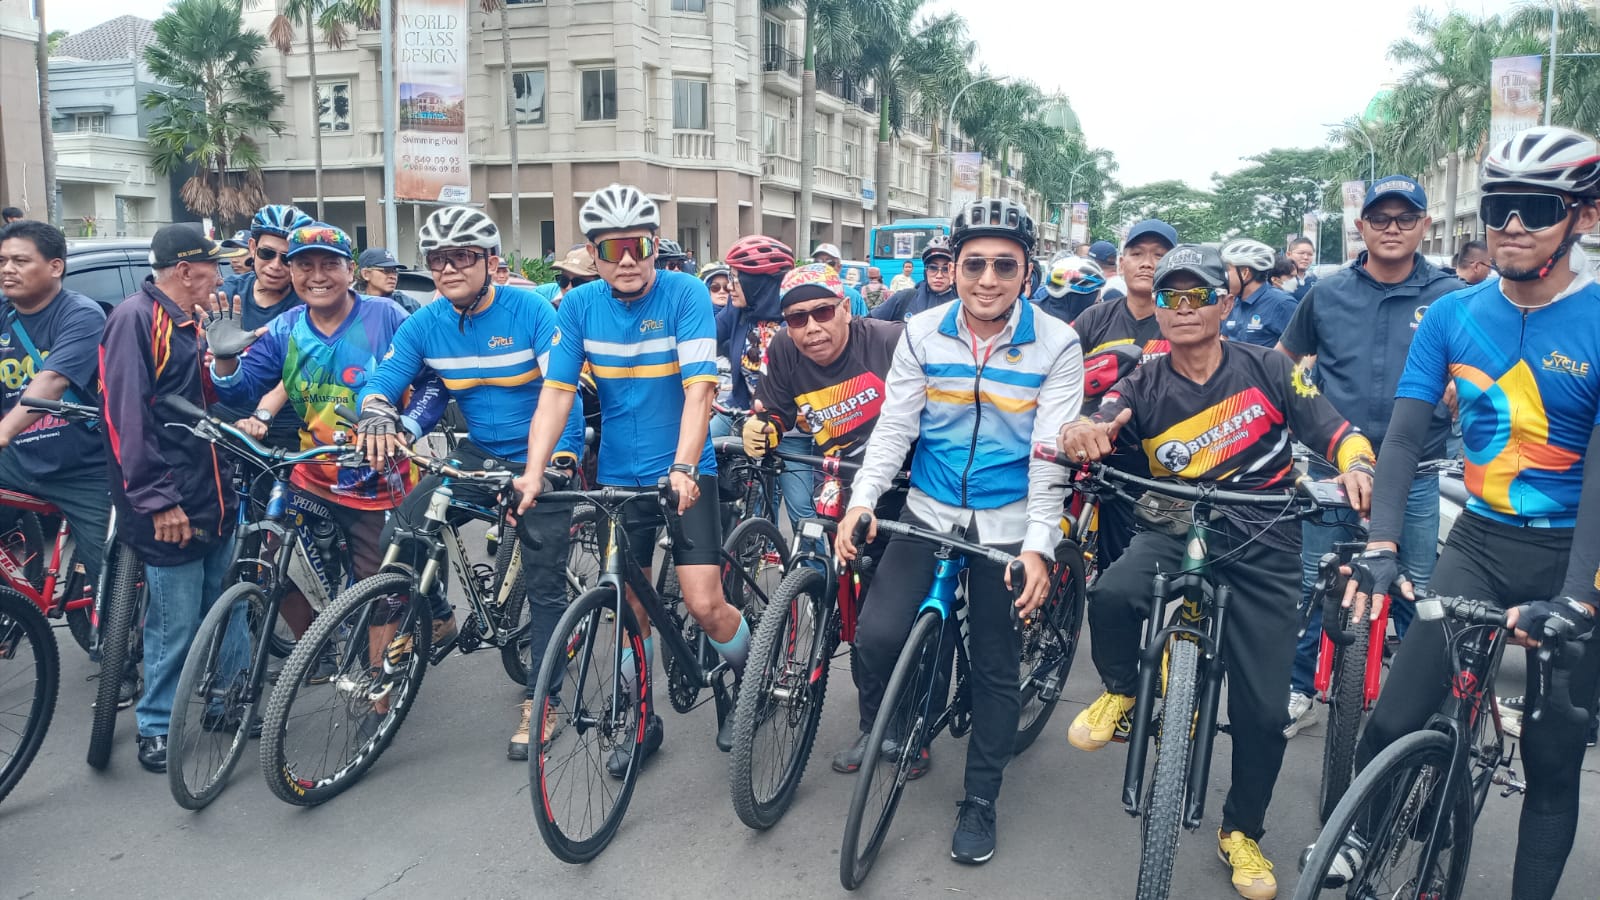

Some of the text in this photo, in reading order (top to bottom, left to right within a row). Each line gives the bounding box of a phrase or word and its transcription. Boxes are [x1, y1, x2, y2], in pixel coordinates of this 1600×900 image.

[400, 14, 457, 29] WORLD
[405, 31, 454, 46] CLASS
[401, 48, 457, 63] DESIGN
[402, 135, 458, 146] Swimming Pool
[817, 386, 880, 422] BUKAPER
[1186, 404, 1266, 455] BUKAPER
